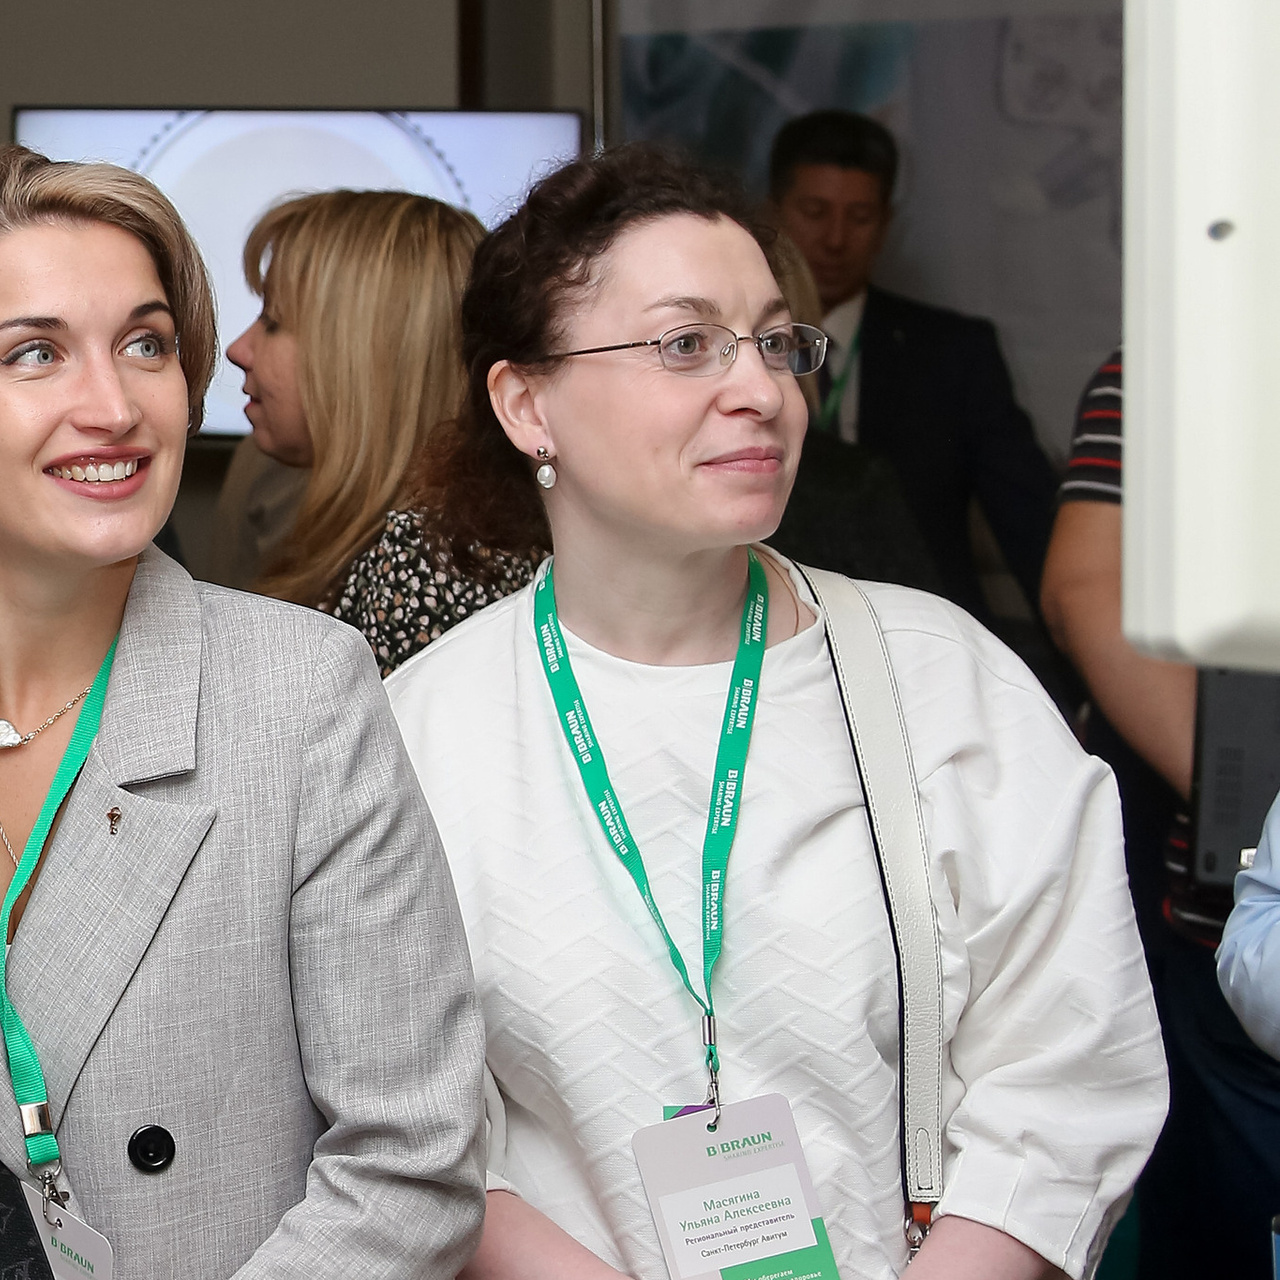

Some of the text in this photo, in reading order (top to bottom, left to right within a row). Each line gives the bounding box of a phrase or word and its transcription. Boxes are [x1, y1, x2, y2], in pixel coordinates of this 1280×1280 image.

[679, 1197, 791, 1231] Ульяна Алексеевна
[703, 1190, 760, 1211] Масягина
[685, 1213, 795, 1245] Региональный представитель
[701, 1231, 787, 1257] Санкт-Петербург Авитум
